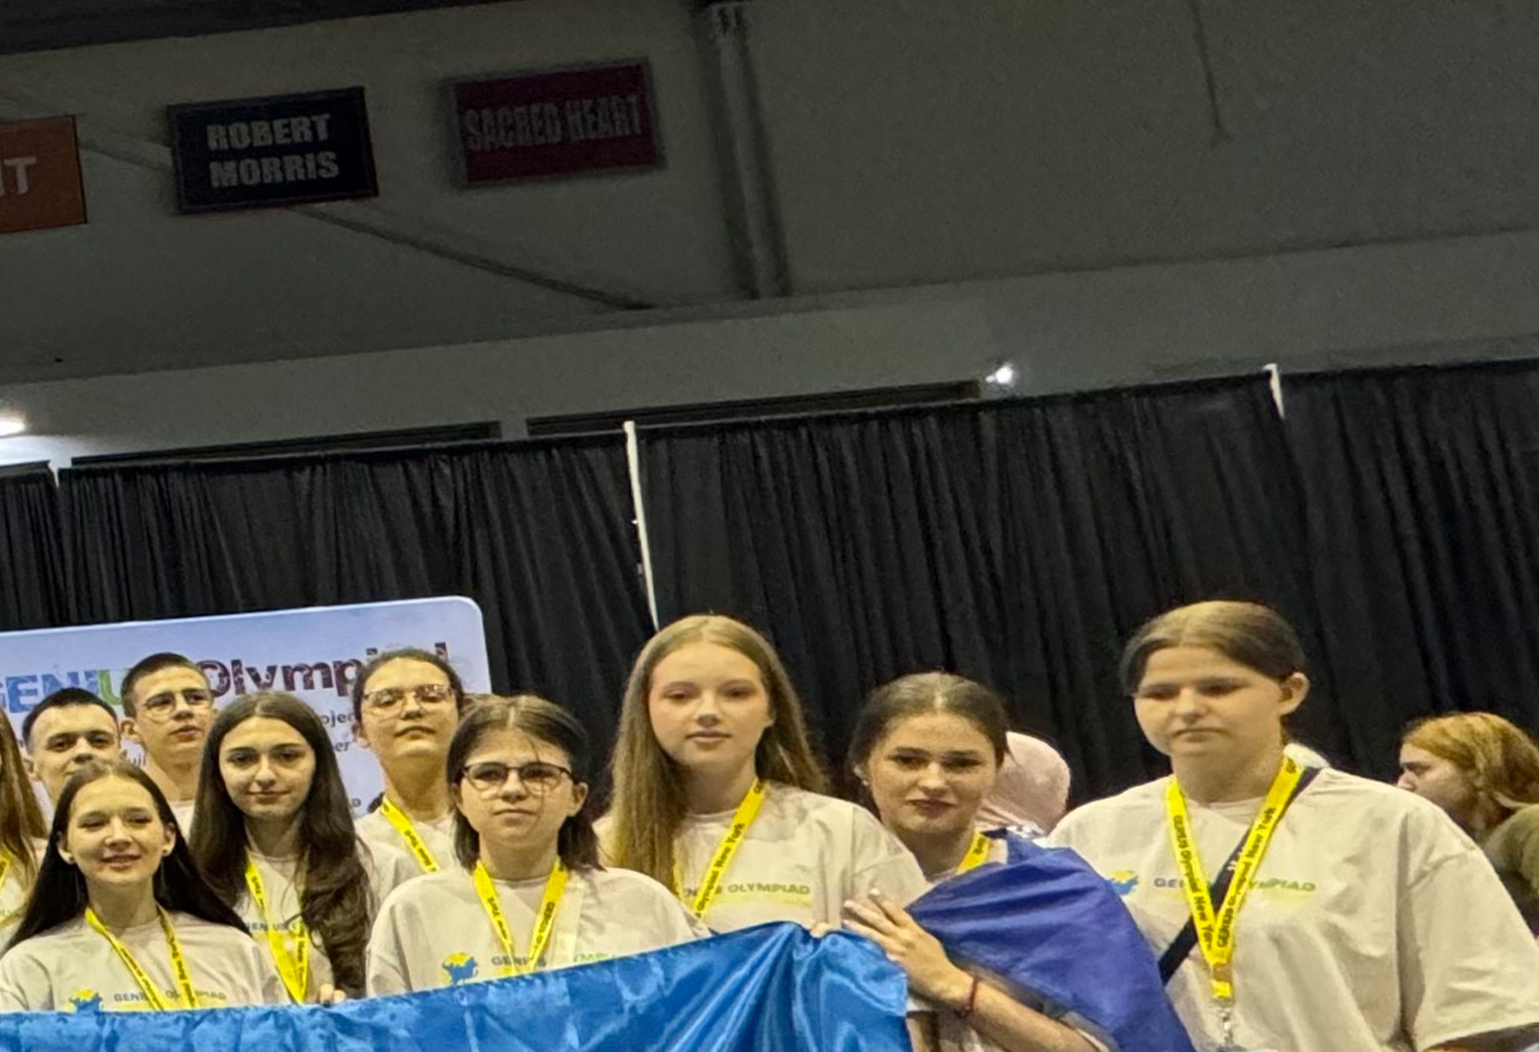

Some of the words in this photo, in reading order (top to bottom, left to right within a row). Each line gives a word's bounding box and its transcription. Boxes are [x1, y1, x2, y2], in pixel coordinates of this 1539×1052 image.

[207, 114, 331, 151] ROBERT
[464, 104, 562, 150] SACRED
[564, 95, 641, 140] HEART
[209, 151, 339, 188] MORRIS
[728, 882, 811, 895] OLYMPIAD
